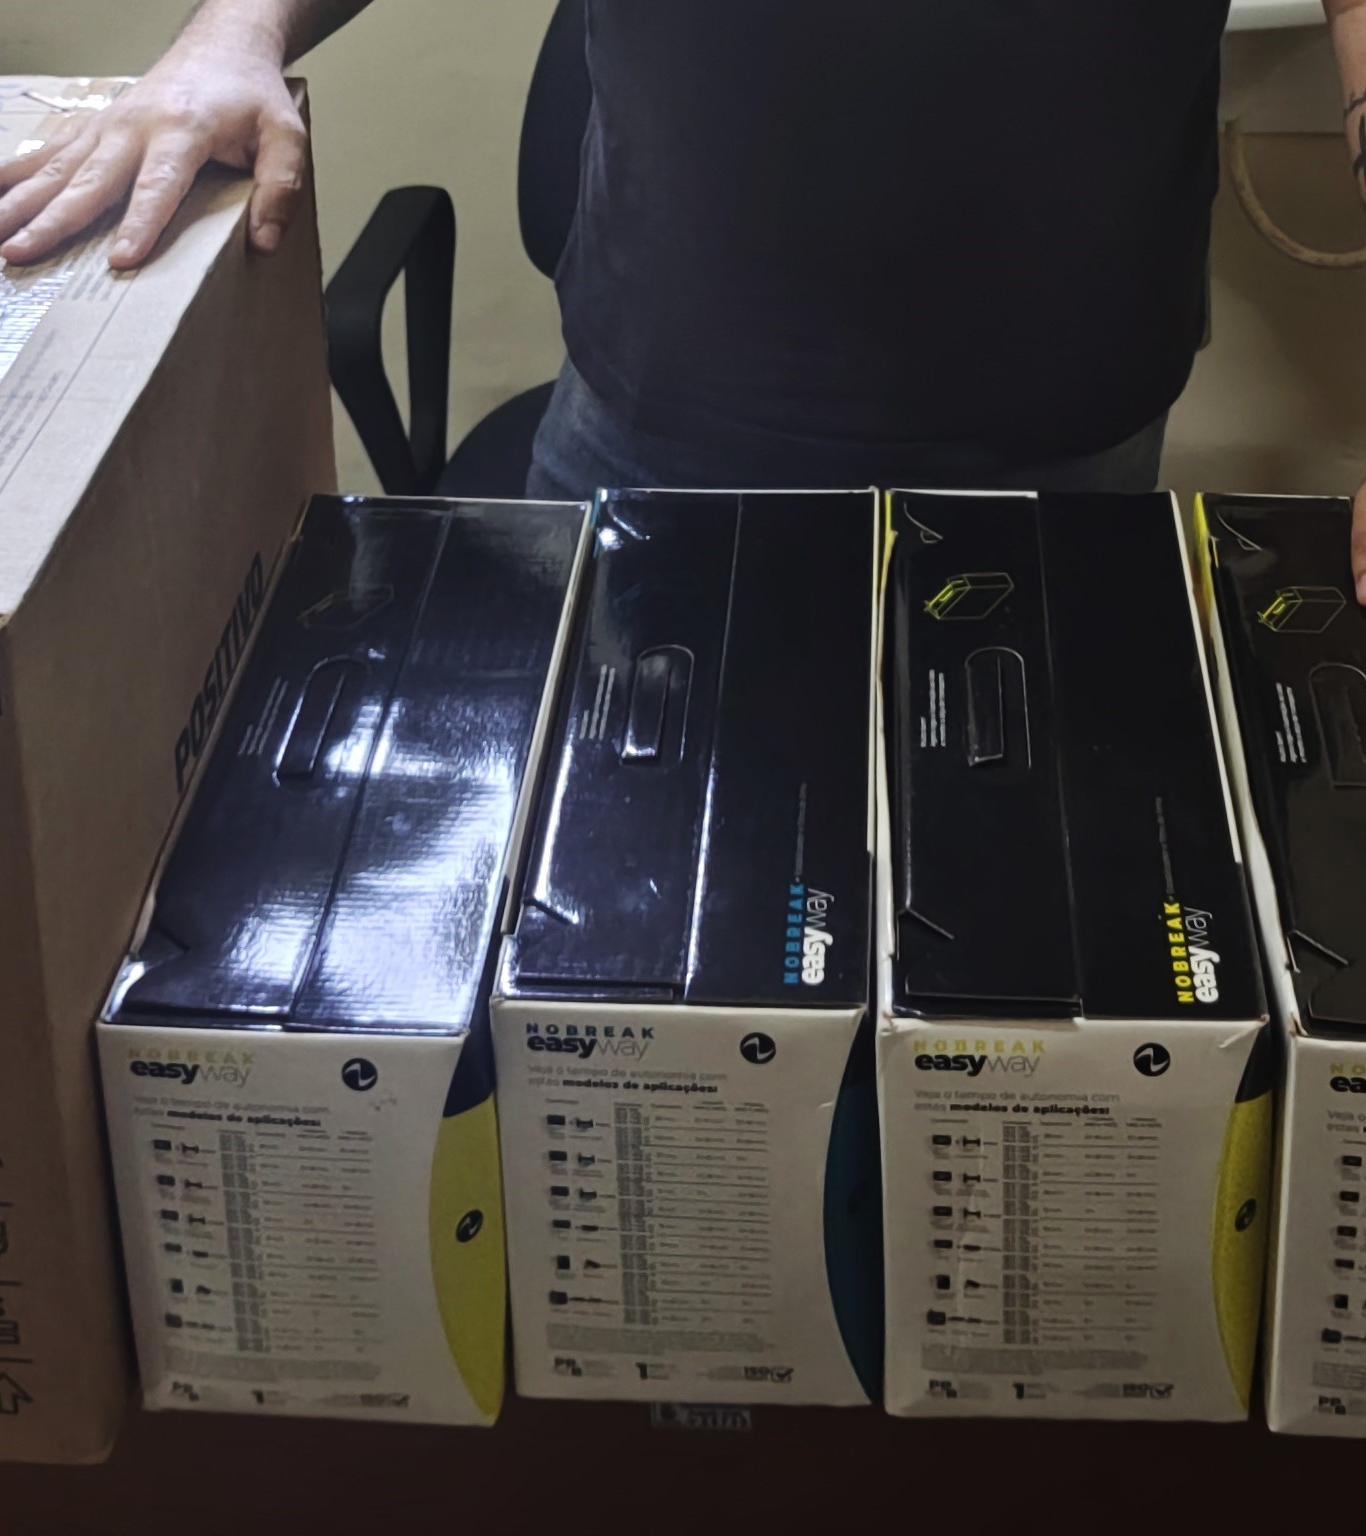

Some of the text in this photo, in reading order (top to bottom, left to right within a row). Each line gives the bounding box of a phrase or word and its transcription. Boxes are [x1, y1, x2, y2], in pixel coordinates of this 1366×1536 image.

[174, 551, 263, 795] POSITIVO
[783, 884, 804, 984] NOBREAK
[801, 888, 835, 985] easyway
[1163, 902, 1195, 1003] NOBREAK
[1184, 906, 1221, 1004] easyway
[525, 1022, 655, 1039] NOBREAK
[526, 1035, 651, 1061] easyway
[913, 1039, 1046, 1053] NOBREAK
[129, 1059, 254, 1086] easyway
[914, 1052, 1041, 1078] easyway
[562, 1079, 619, 1089] modelos
[622, 1080, 639, 1089] de
[642, 1081, 718, 1094] aplicações:
[949, 1103, 1008, 1112] modelos
[1012, 1104, 1029, 1113] de
[1033, 1104, 1110, 1118] aplicações:
